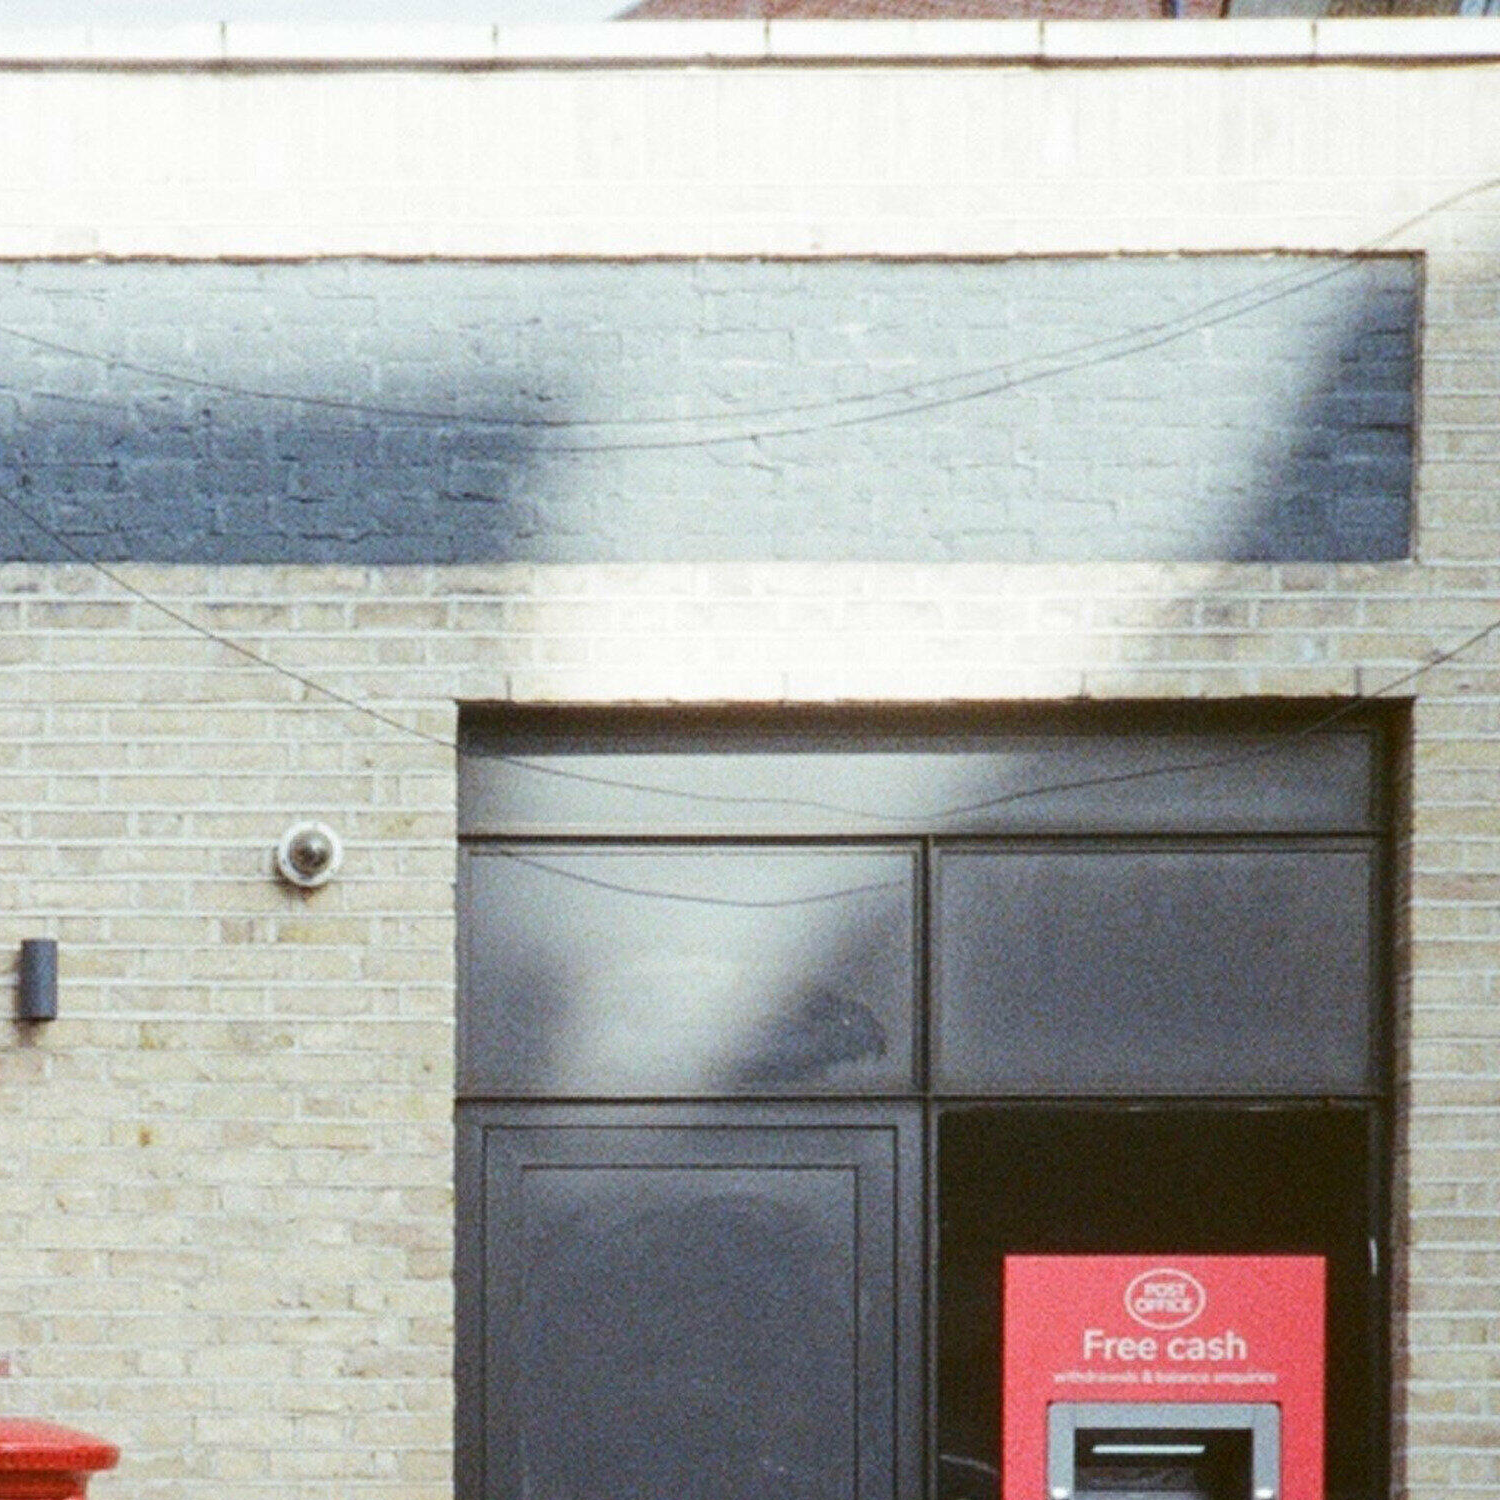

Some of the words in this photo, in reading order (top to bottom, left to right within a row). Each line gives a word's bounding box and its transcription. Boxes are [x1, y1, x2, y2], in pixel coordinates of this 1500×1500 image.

[1144, 1283, 1187, 1297] POST
[1135, 1298, 1193, 1313] OFFICE
[1083, 1329, 1159, 1360] Free
[1167, 1330, 1248, 1360] cash
